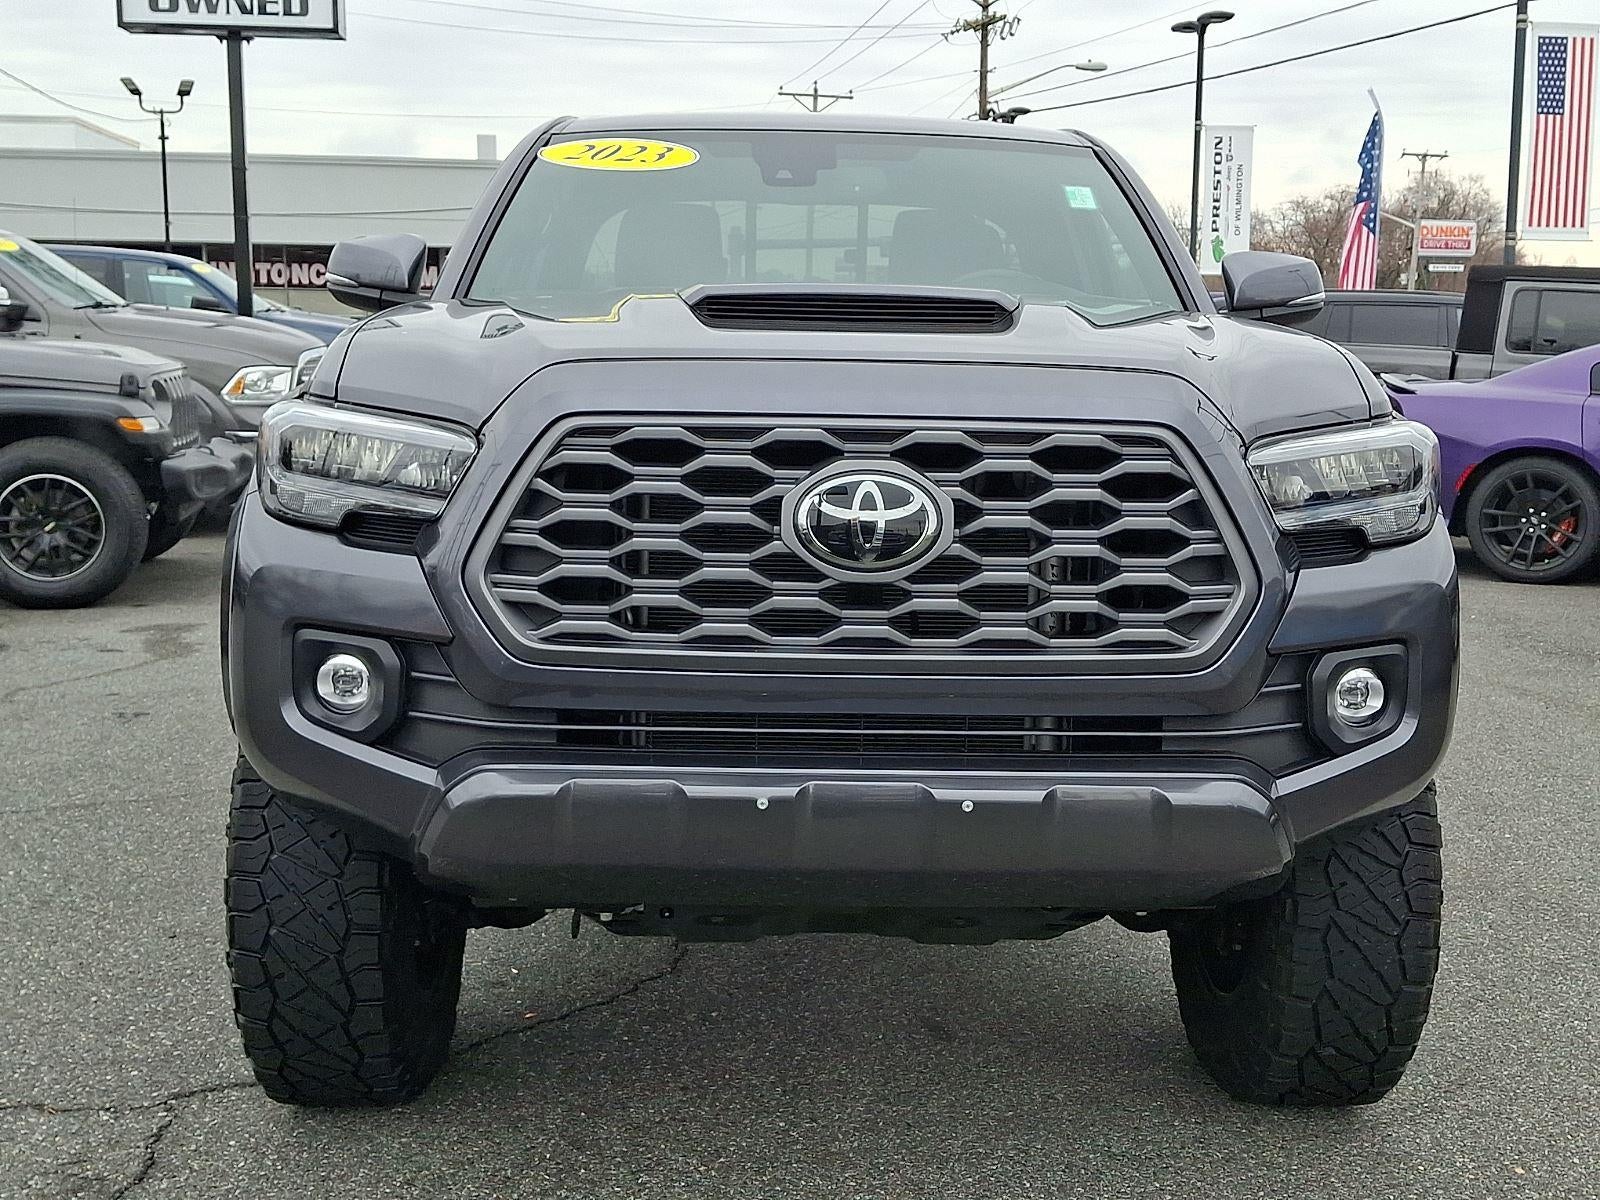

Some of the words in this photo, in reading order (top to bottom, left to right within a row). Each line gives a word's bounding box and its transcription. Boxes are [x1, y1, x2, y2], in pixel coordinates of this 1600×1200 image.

[564, 144, 674, 163] 2023
[1211, 136, 1223, 233] PRESTON
[1235, 164, 1243, 221] WILMINGTON
[1234, 224, 1241, 236] OF
[1423, 240, 1446, 248] DRIVE
[1447, 240, 1469, 248] THRU
